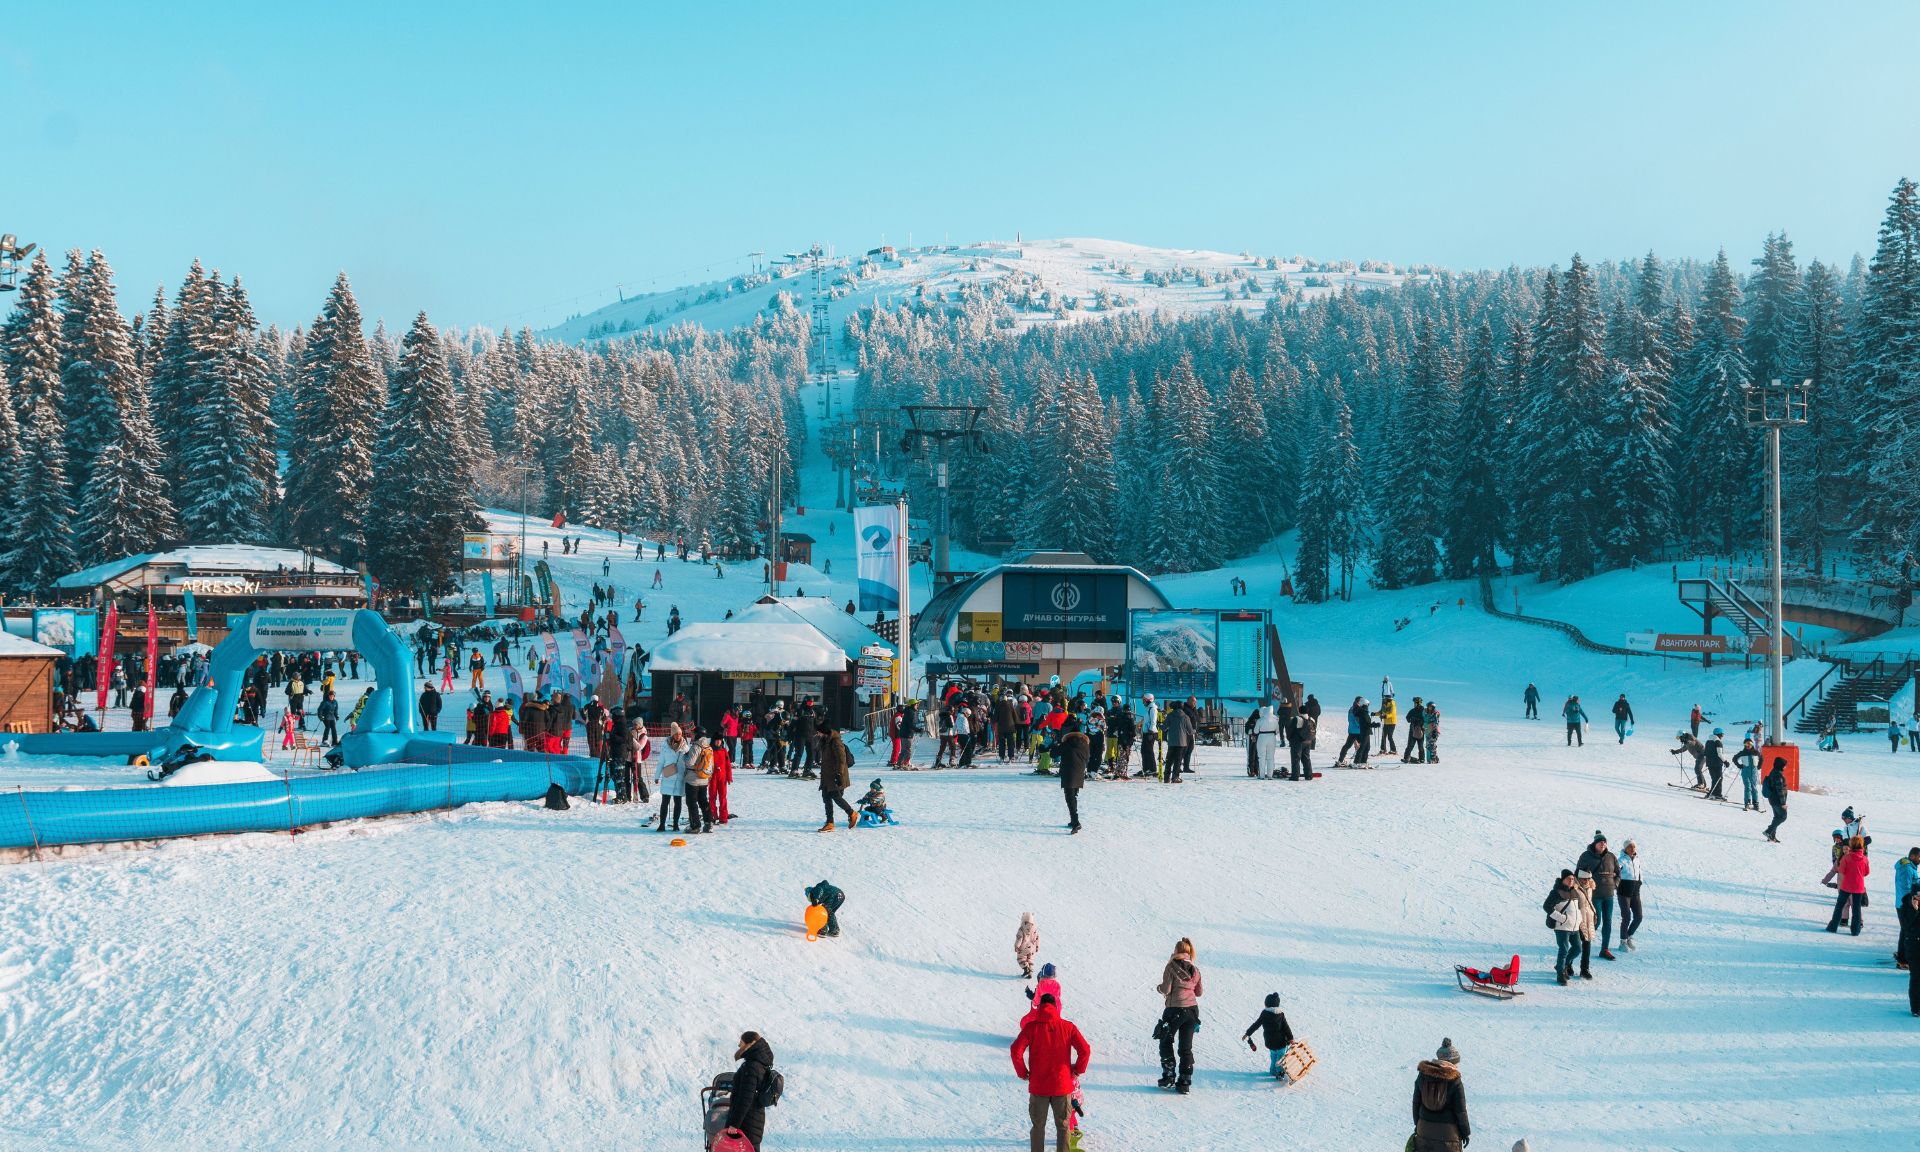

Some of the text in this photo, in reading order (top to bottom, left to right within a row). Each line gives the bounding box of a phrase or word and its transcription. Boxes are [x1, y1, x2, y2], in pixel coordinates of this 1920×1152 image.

[1023, 614, 1107, 622] ДУНАВ ОСИГУРАЊЕ
[256, 628, 308, 636] Kids snowmobile
[1660, 639, 1720, 648] АВАНТУРА ПАРК
